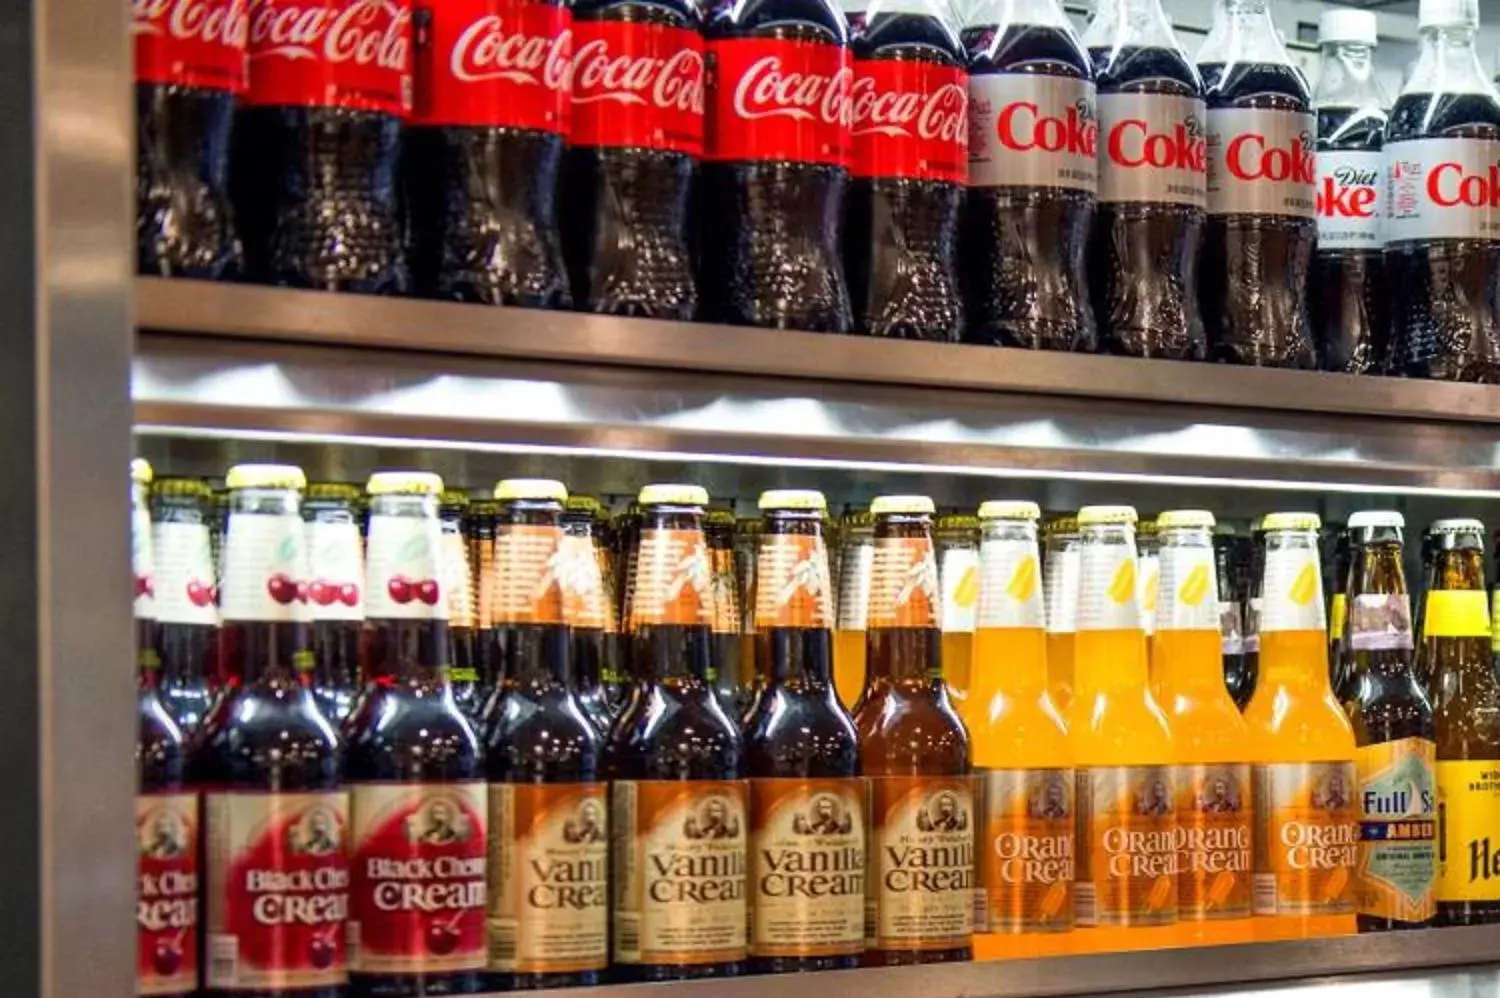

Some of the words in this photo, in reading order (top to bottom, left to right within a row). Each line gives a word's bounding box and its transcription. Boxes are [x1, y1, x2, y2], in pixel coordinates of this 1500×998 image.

[1334, 165, 1378, 186] Diet
[1316, 177, 1378, 218] ke
[1363, 790, 1407, 814] Full
[367, 857, 429, 879] Black
[246, 869, 311, 892] Black
